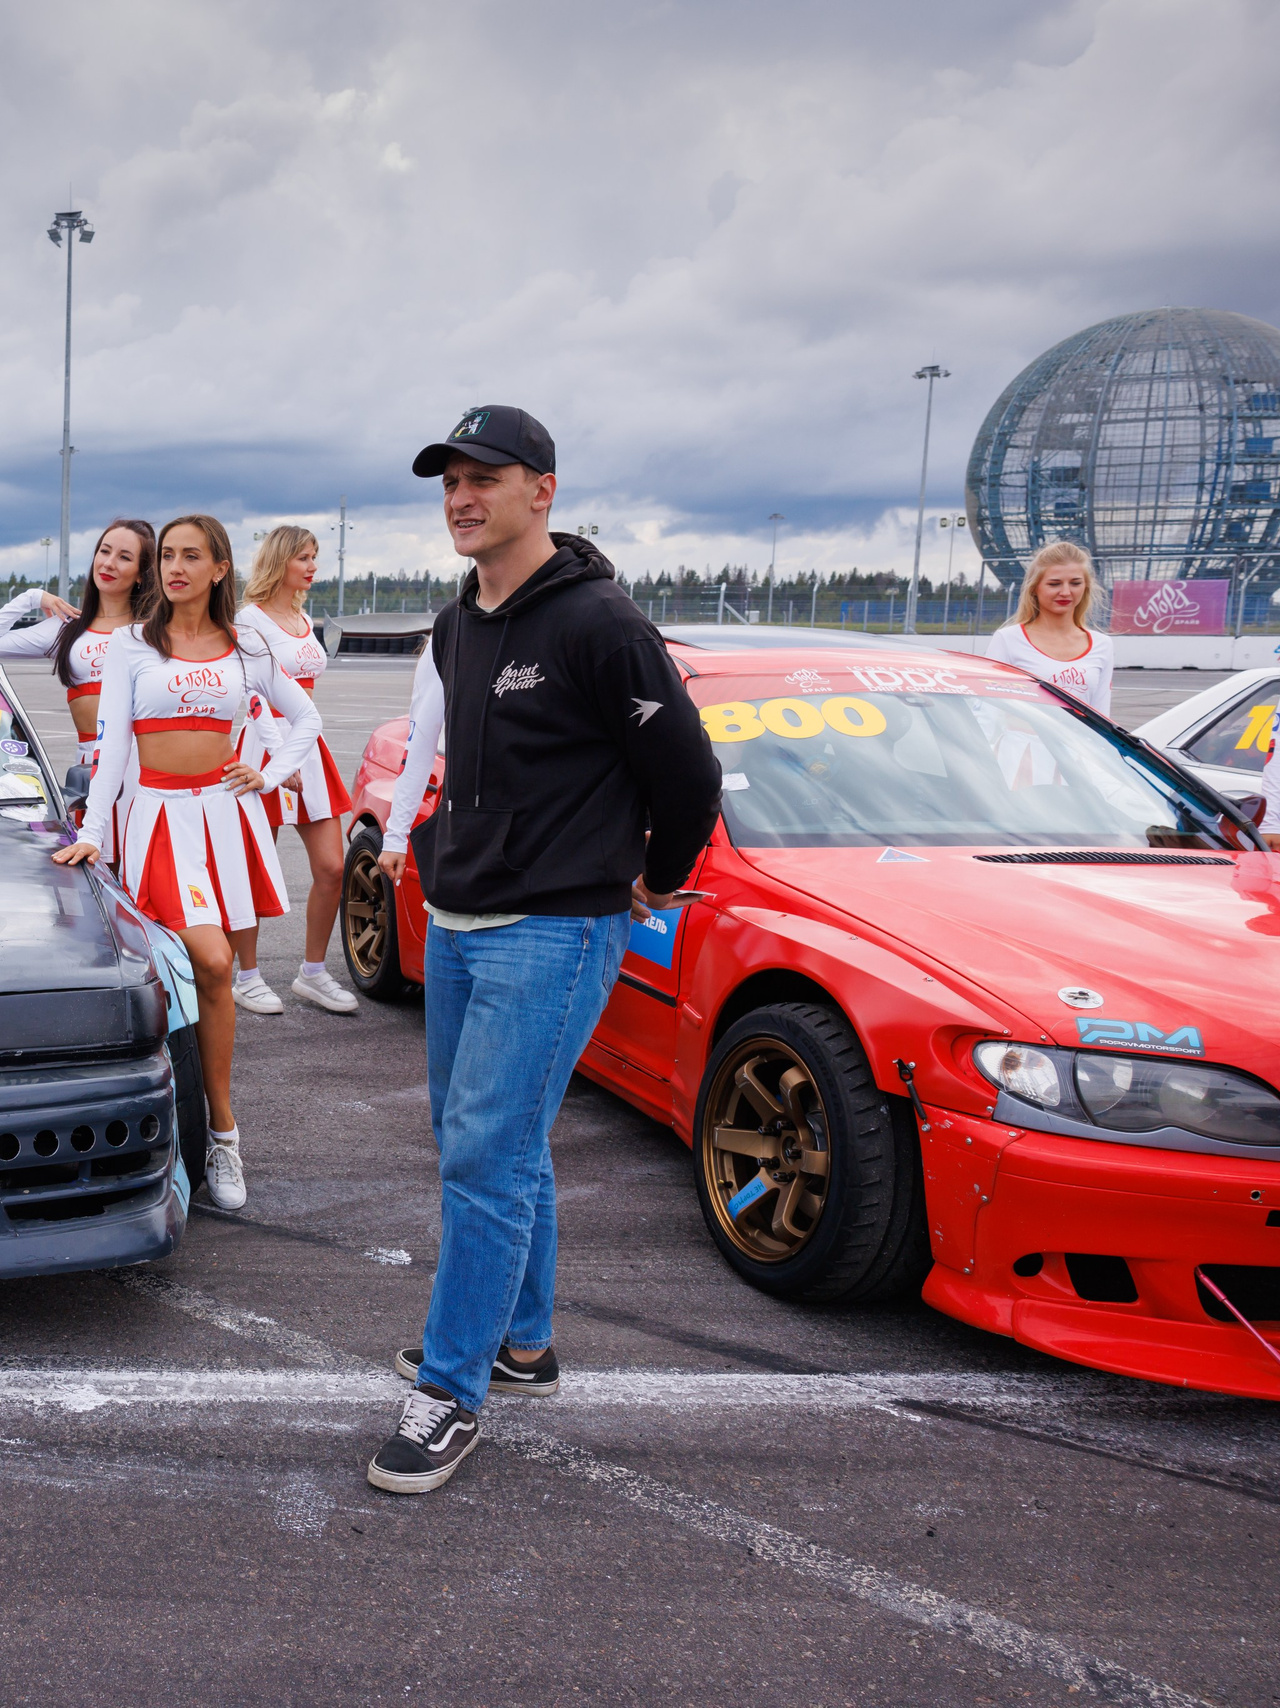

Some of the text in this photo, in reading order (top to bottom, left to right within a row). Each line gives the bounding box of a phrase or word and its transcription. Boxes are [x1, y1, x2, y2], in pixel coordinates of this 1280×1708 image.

[496, 660, 540, 684] Saint
[852, 670, 970, 690] IDDC
[492, 676, 545, 698] Ghetto
[905, 686, 978, 696] CHALLENGE
[177, 705, 216, 715] ДРАЙВ
[699, 697, 887, 743] 800
[643, 915, 668, 934] КЕЛЬ
[1099, 1039, 1202, 1055] POPOVMOTORSPORT
